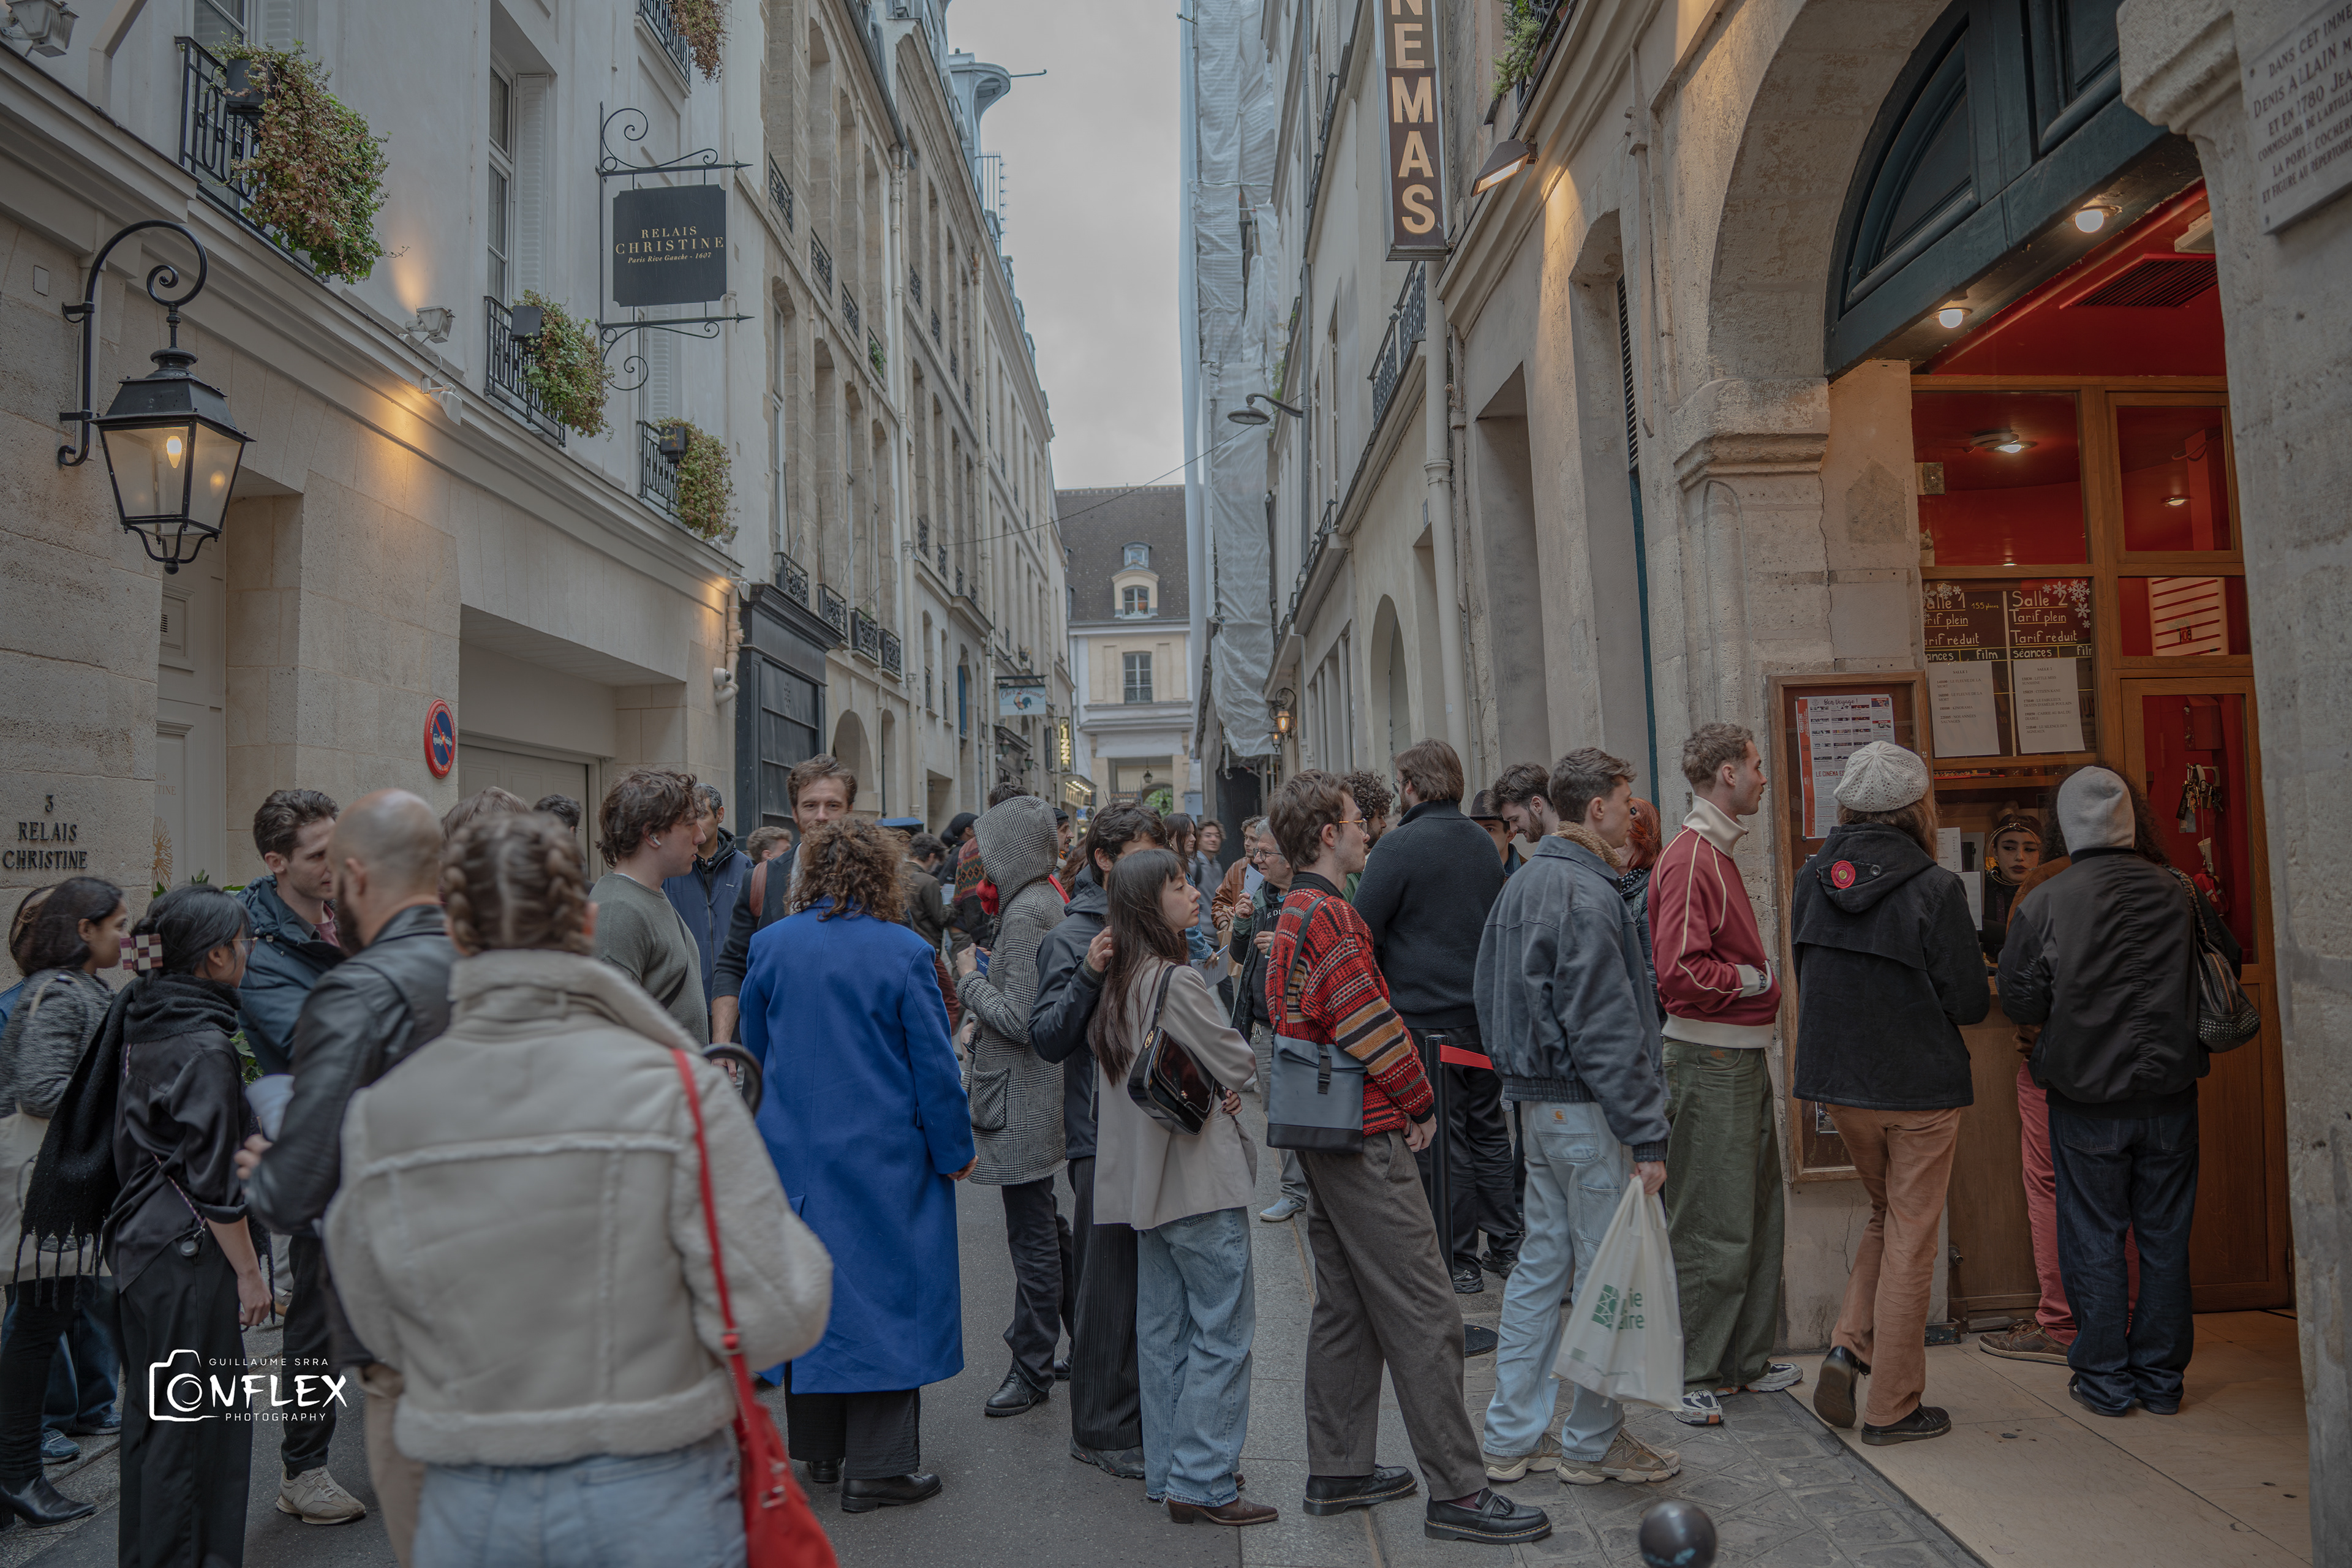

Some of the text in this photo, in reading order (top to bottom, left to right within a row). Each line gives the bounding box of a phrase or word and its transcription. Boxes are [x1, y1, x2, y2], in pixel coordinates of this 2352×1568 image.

[2269, 47, 2294, 78] DANS
[2299, 28, 2319, 54] CET
[2254, 86, 2285, 118] DENIS
[2289, 42, 2337, 94] ALLAIN
[2269, 118, 2278, 137] ET
[2282, 107, 2294, 127] EN
[2297, 85, 2324, 116] 1780
[2258, 123, 2303, 162] COMMISSAIRE
[2306, 115, 2315, 130] DE
[2272, 162, 2283, 177] LA
[2285, 142, 2312, 168] PORTE
[2262, 189, 2271, 203] ET
[2272, 172, 2297, 197] FIGURE
[2299, 165, 2309, 181] AU
[641, 225, 697, 239] RELAIS
[615, 236, 724, 254] CHRISTINE
[1923, 592, 1966, 609] alle 1
[2012, 590, 2049, 607] Salle
[2058, 594, 2068, 606] 2
[1924, 612, 1969, 630] rif plein
[2008, 609, 2067, 627] Tarif plein
[1924, 632, 1980, 645] arif réduit
[2010, 630, 2078, 643] Tarif réduit
[1926, 649, 1998, 661] ances film
[2013, 648, 2052, 658] séances
[45, 794, 54, 812] 3
[18, 821, 78, 842] RELAIS
[2, 850, 88, 869] CHRISTINE
